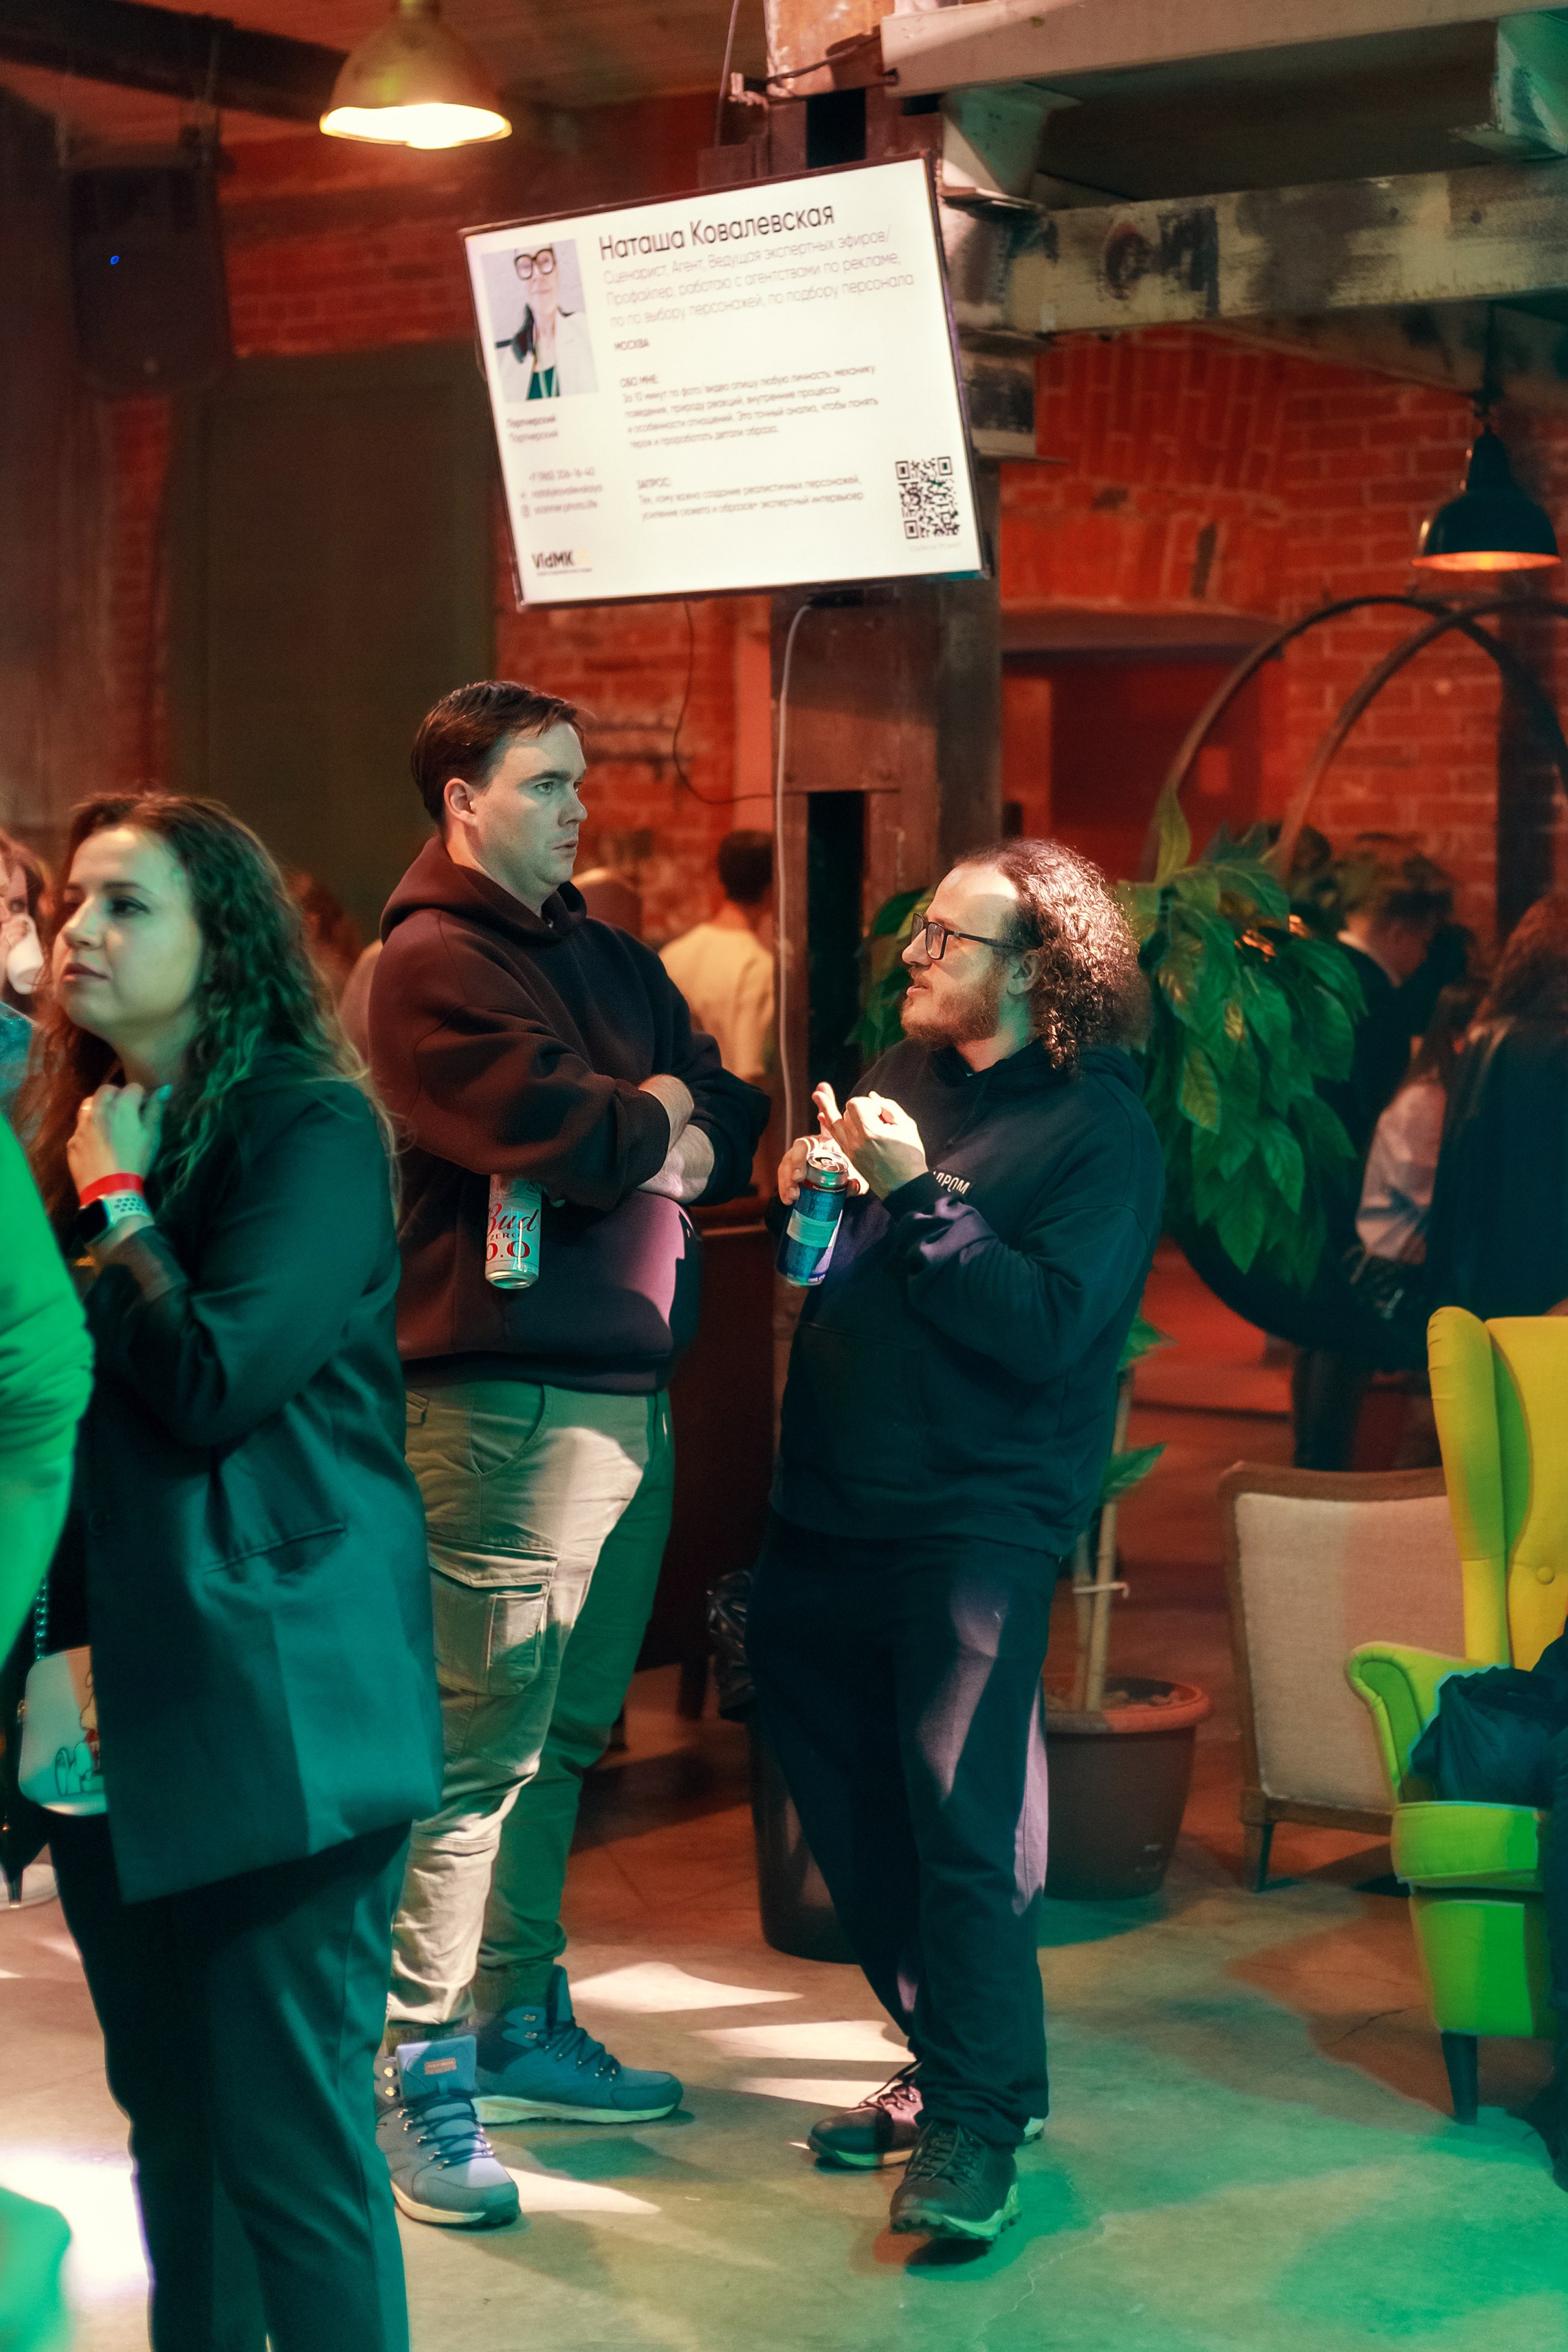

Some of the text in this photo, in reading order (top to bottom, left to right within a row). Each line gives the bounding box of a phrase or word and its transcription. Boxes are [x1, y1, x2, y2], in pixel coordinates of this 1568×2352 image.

[599, 205, 834, 260] Наташа Ковалевская
[603, 264, 669, 285] Сценарист,
[671, 258, 705, 273] Агент,
[707, 250, 762, 269] Ведущая
[763, 239, 835, 260] экспертных
[606, 252, 902, 306] Профайлер, работаю с агентствами по рекламе,
[786, 285, 839, 302] подбору
[842, 273, 915, 295] персонала
[488, 1203, 540, 1235] Bud
[486, 1240, 531, 1262] 0.0
[489, 1232, 521, 1241] ZERO
